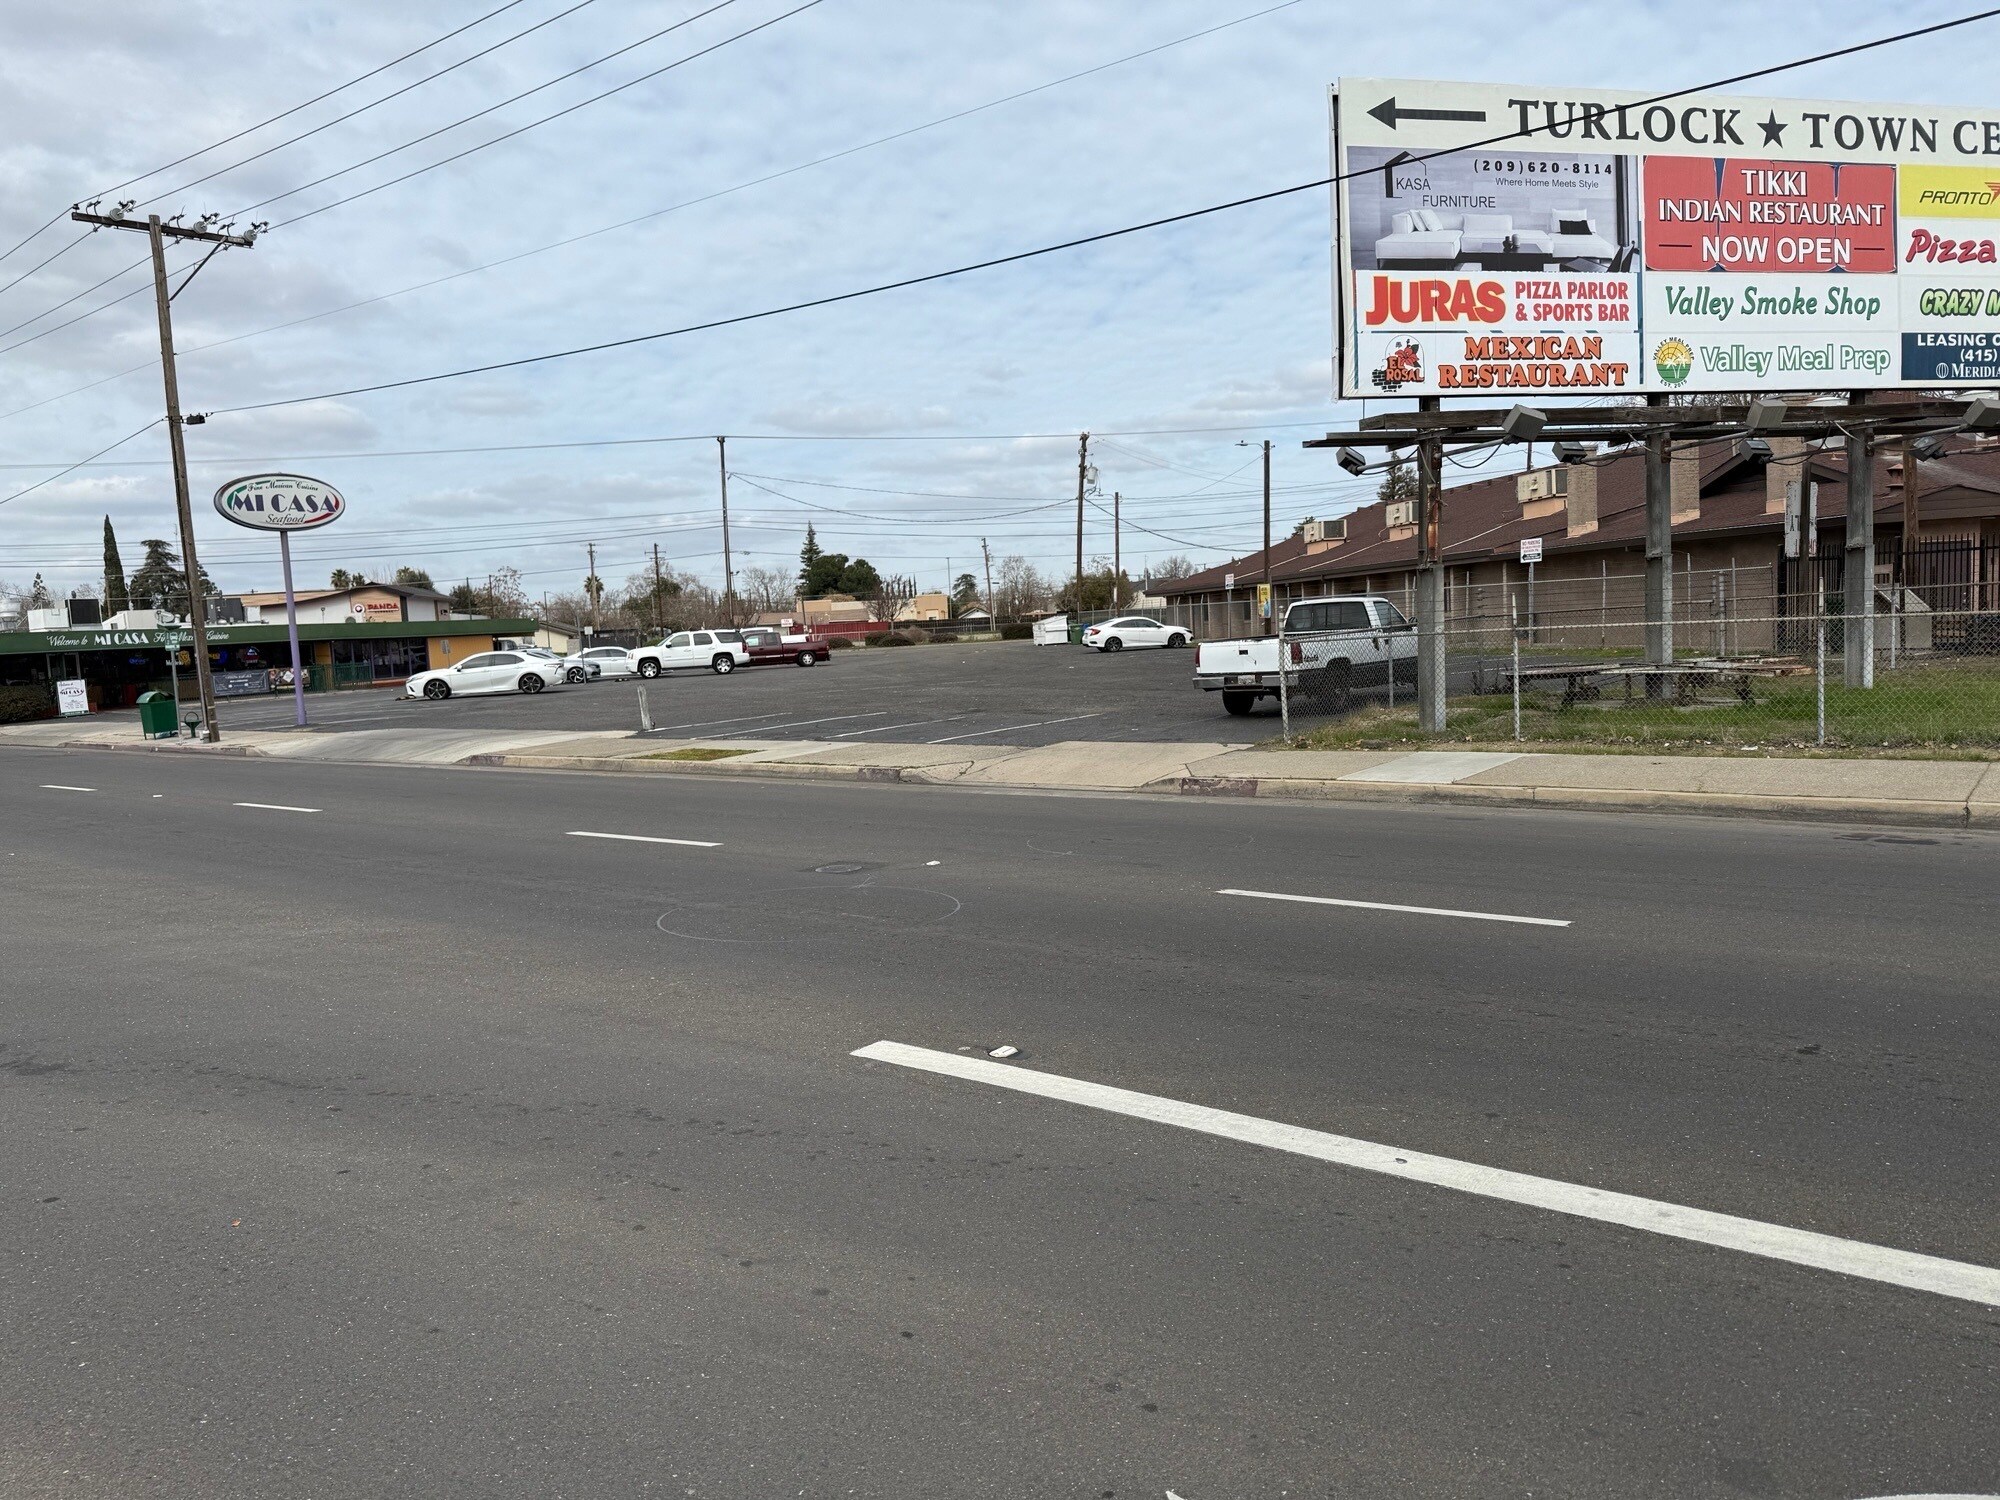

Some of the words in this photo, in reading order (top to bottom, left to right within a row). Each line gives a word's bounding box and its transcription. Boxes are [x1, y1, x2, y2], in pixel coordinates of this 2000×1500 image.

[1508, 98, 1744, 145] TURLOCK
[1802, 112, 1938, 152] TOWN
[1953, 120, 2000, 154] CE
[1474, 159, 1612, 175] (209)620-8114
[1396, 177, 1431, 191] KASA
[1495, 178, 1522, 187] Where
[1525, 178, 1550, 188] Home
[1551, 179, 1576, 188] Meets
[1578, 180, 1599, 189] Style
[1741, 168, 1807, 197] TIKKI
[1422, 195, 1496, 208] FURNITURE
[1919, 190, 1992, 205] PRONTO
[1658, 199, 1741, 222] INDIAN
[1750, 201, 1886, 227] RESTAURANT
[1702, 236, 1769, 263] NOW
[1777, 237, 1851, 264] OPEN
[1905, 228, 1997, 263] Pizza
[1515, 281, 1562, 299] PIZZA
[1567, 281, 1628, 299] PARLOR
[1366, 276, 1506, 325] JURAS
[1665, 285, 1734, 321] Valley
[1740, 286, 1817, 315] Smoke
[1824, 286, 1881, 321] Shop
[1920, 288, 1984, 317] CRAZY
[1515, 303, 1528, 321] &
[1533, 303, 1593, 321] SPORTS
[1598, 303, 1630, 321] BAR
[1464, 336, 1603, 361] MEXICAN
[1917, 333, 1987, 346] LEASING
[1386, 356, 1405, 369] EL
[1699, 345, 1772, 377] Valley
[1778, 343, 1833, 370] Meal
[1840, 346, 1891, 375] Prep
[1960, 349, 1998, 362] (415)
[1385, 368, 1425, 382] ROSAL
[1438, 363, 1628, 388] RESTAURANT
[247, 483, 263, 492] Fine
[265, 481, 293, 489] Mexican
[295, 481, 318, 491] Cuisine
[232, 493, 265, 512] MI
[270, 493, 336, 513] CASA
[265, 513, 306, 525] Seafood
[367, 602, 399, 610] PANDA
[46, 635, 80, 646] Welcome
[80, 634, 88, 645] to
[94, 633, 111, 646] MI
[113, 632, 149, 645] CASA
[205, 630, 229, 641] Cuisine
